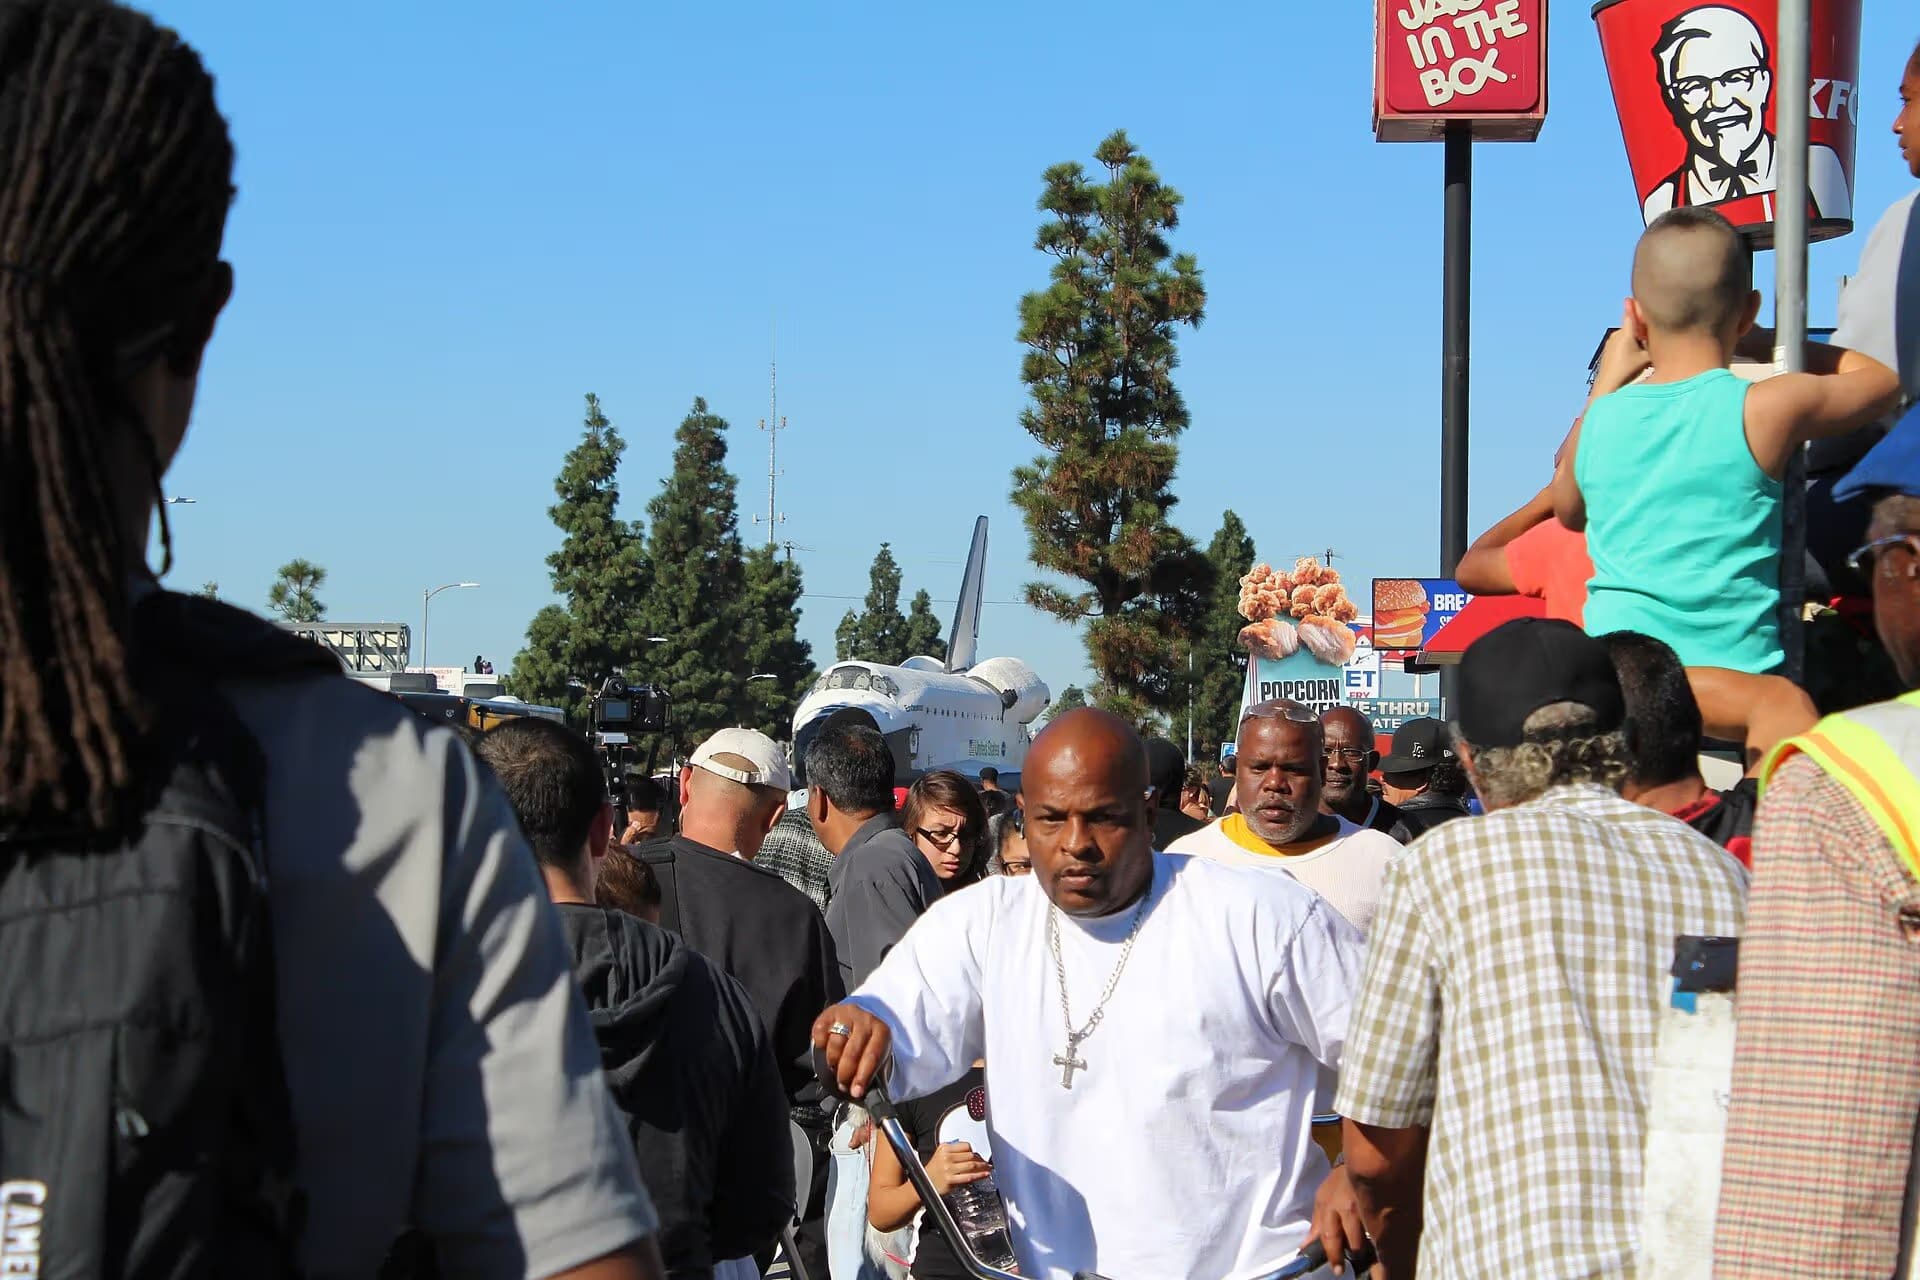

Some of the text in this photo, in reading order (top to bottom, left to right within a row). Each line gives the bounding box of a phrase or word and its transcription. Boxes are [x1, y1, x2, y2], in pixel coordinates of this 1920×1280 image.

[1452, 0, 1528, 50] THE
[1419, 48, 1509, 107] BOX
[1260, 679, 1340, 703] POPCORN
